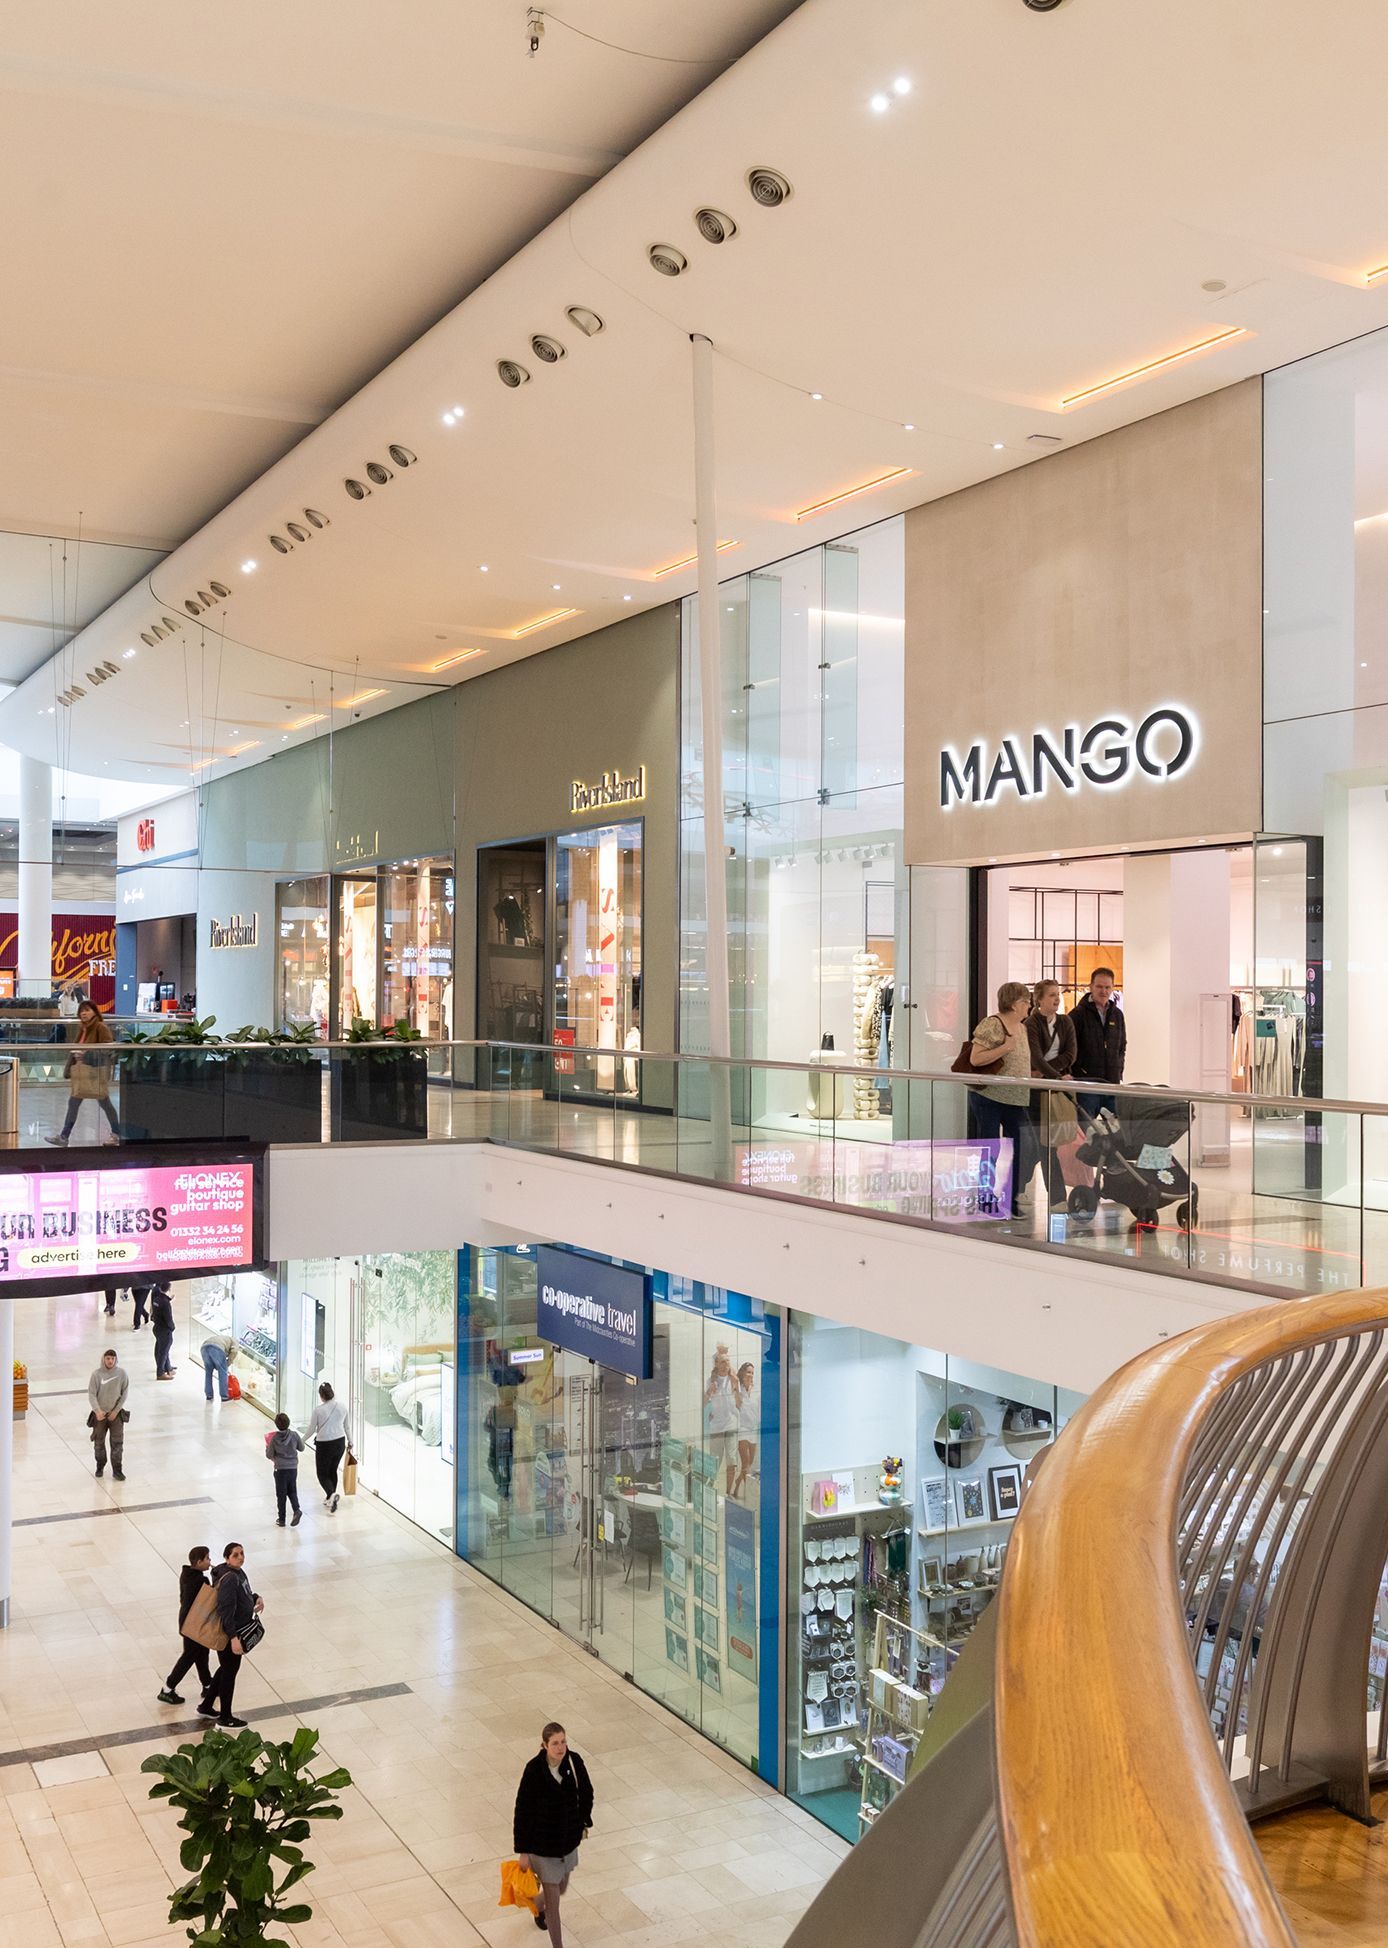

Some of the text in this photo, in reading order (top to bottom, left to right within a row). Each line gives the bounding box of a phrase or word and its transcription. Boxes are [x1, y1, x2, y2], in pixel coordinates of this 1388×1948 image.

[940, 709, 1194, 807] MANGO
[187, 1188, 244, 1202] boutique
[170, 1199, 244, 1215] guitar shop
[42, 1207, 168, 1239] BUSINESS
[187, 1235, 241, 1246] elonex.com
[97, 1248, 126, 1260] here
[542, 1285, 637, 1337] co-operative travel
